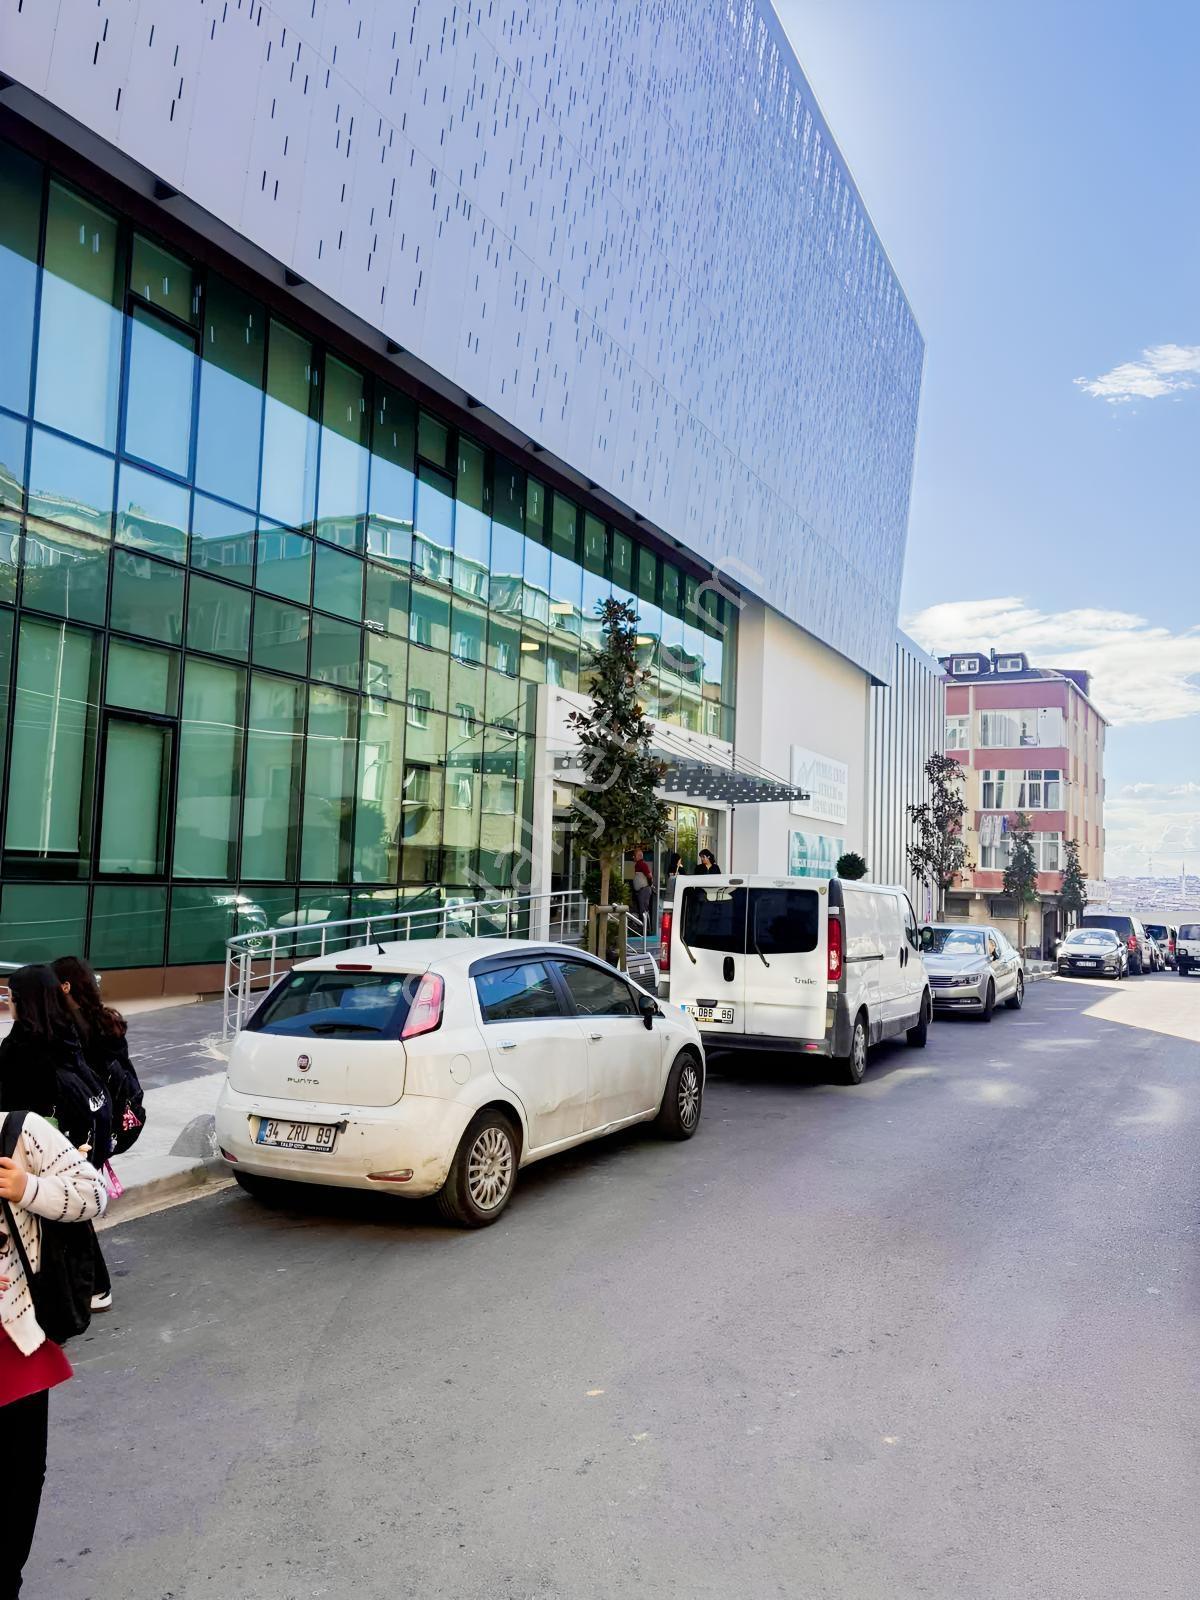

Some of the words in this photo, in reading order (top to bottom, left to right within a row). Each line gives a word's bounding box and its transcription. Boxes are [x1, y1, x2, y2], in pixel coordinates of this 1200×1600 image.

[287, 1077, 320, 1085] PUNTO
[266, 1122, 279, 1139] 34
[287, 1124, 310, 1142] ZRU
[316, 1127, 332, 1145] 89
